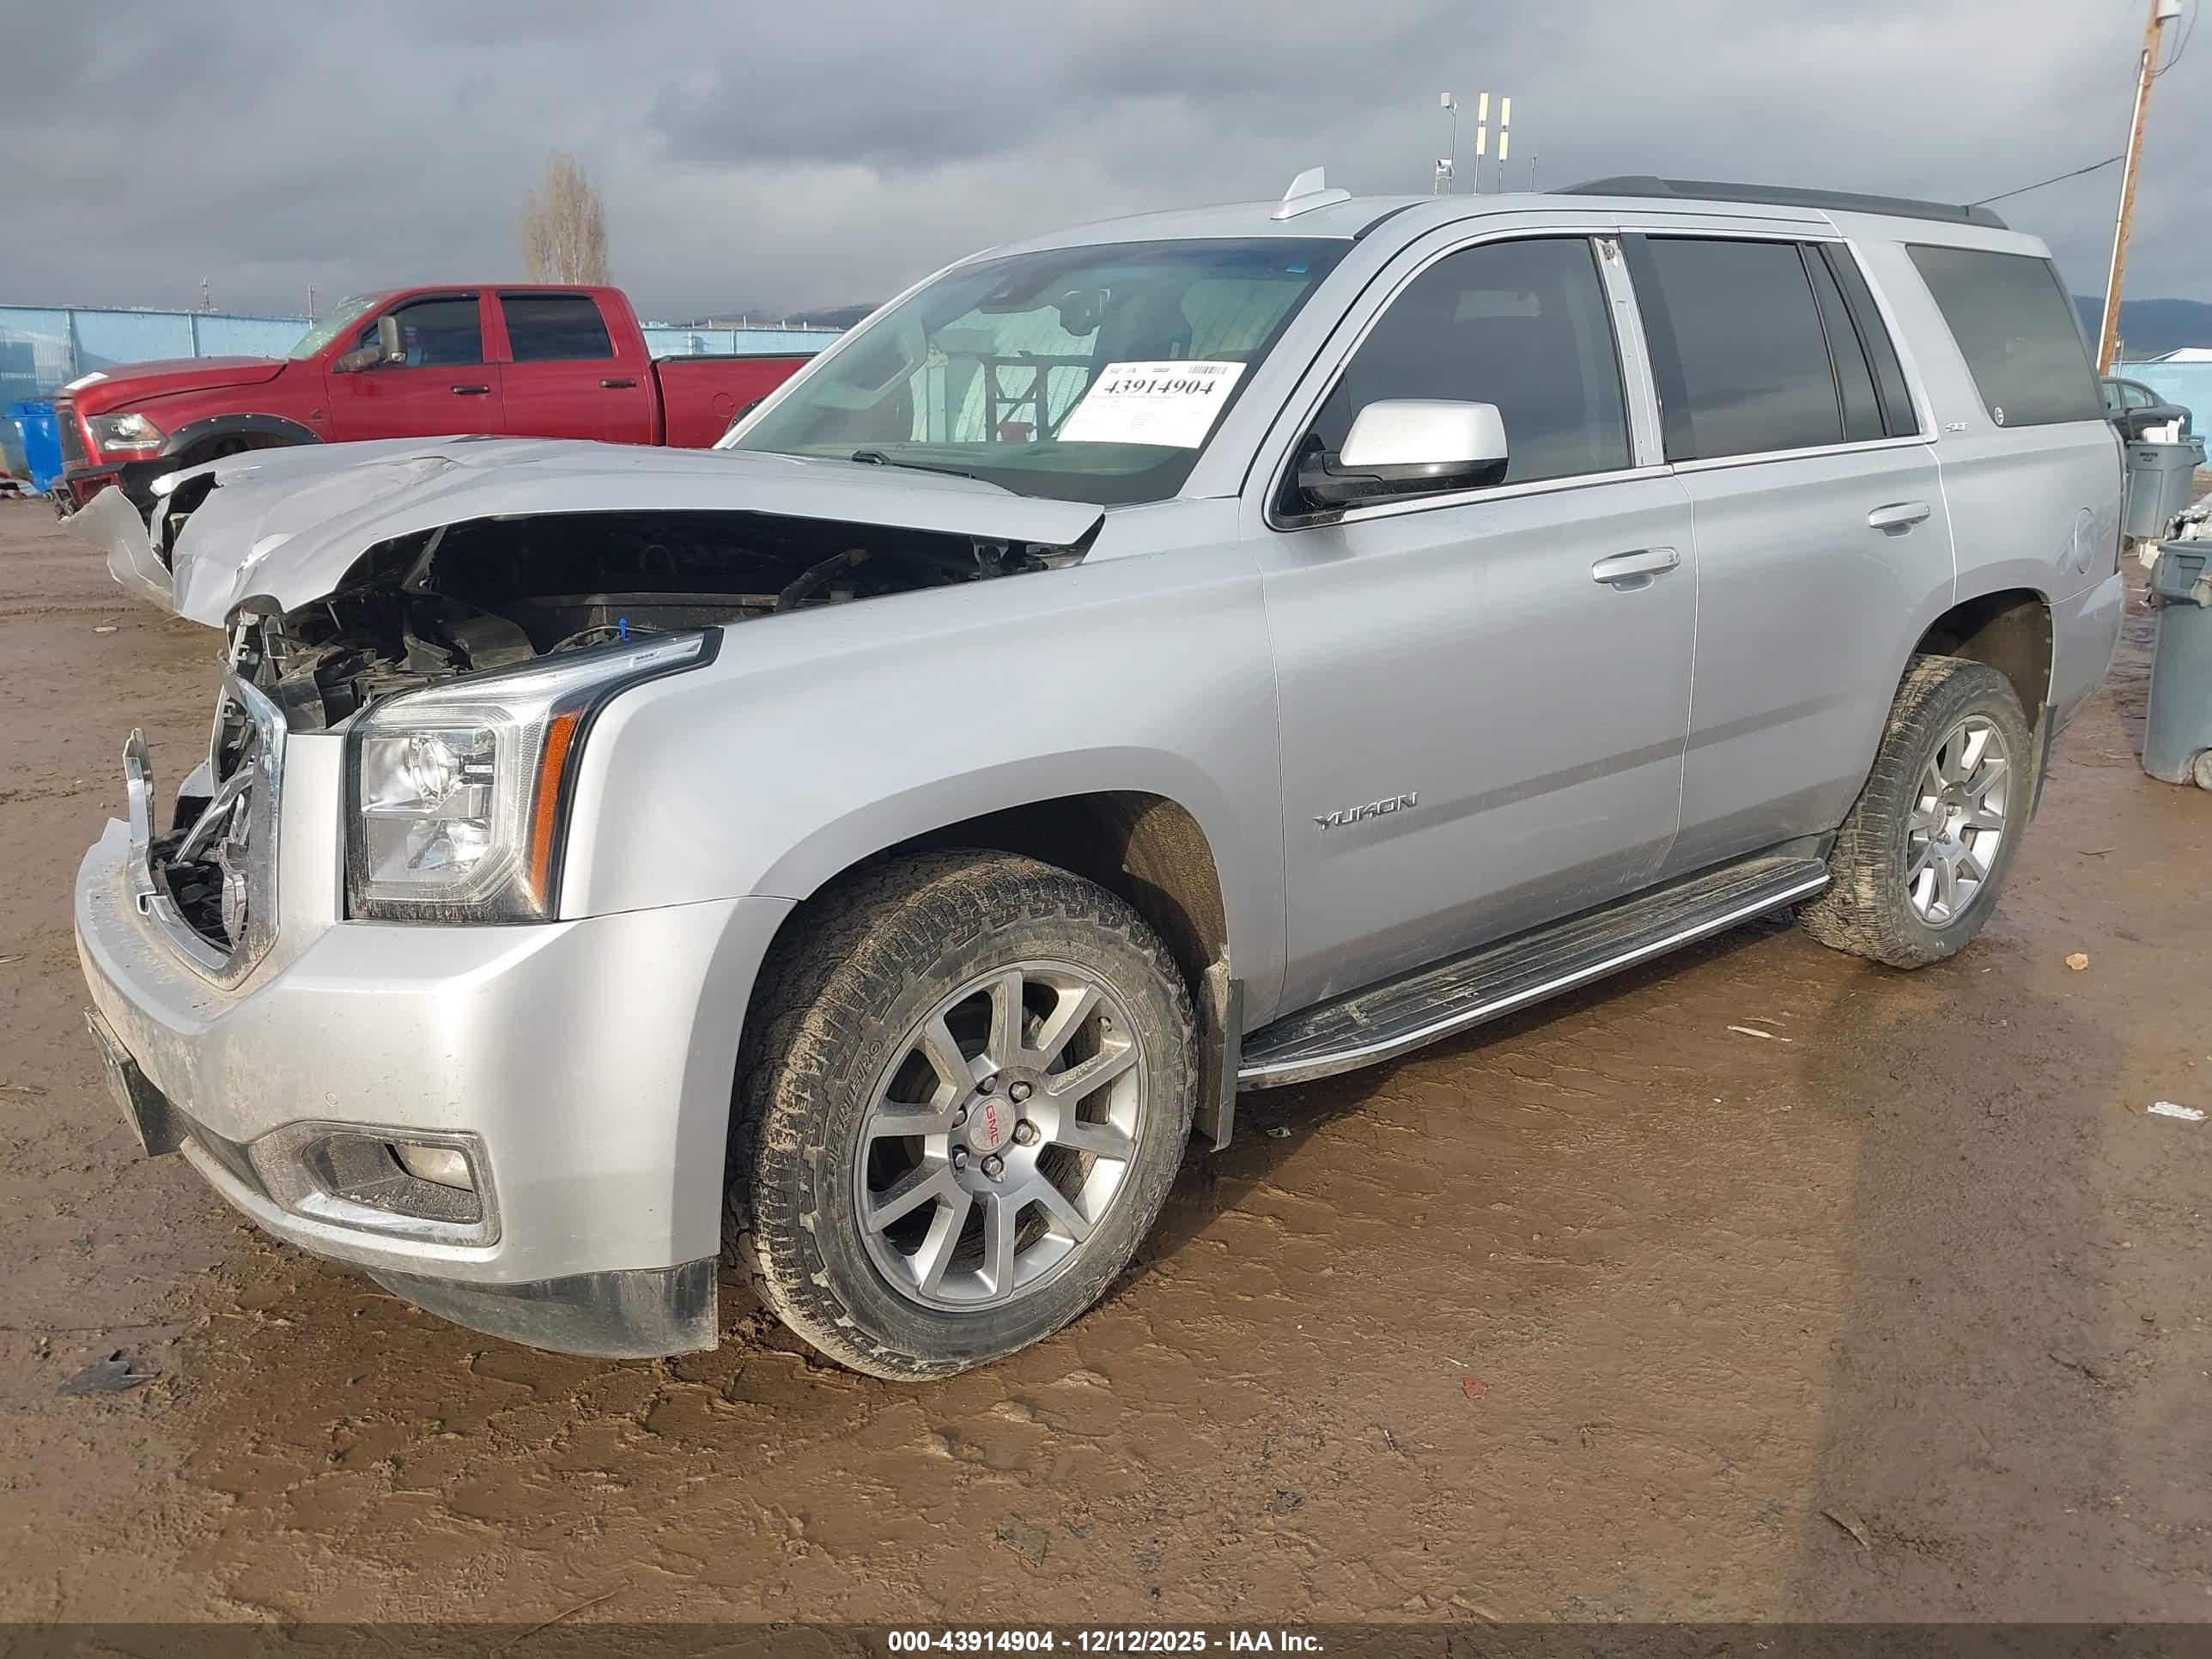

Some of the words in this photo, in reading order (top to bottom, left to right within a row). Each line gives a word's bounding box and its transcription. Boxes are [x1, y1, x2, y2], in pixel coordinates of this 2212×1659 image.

[1104, 379, 1216, 394] 43914904
[1312, 792, 1417, 830] YUKON
[985, 1104, 999, 1147] GMC
